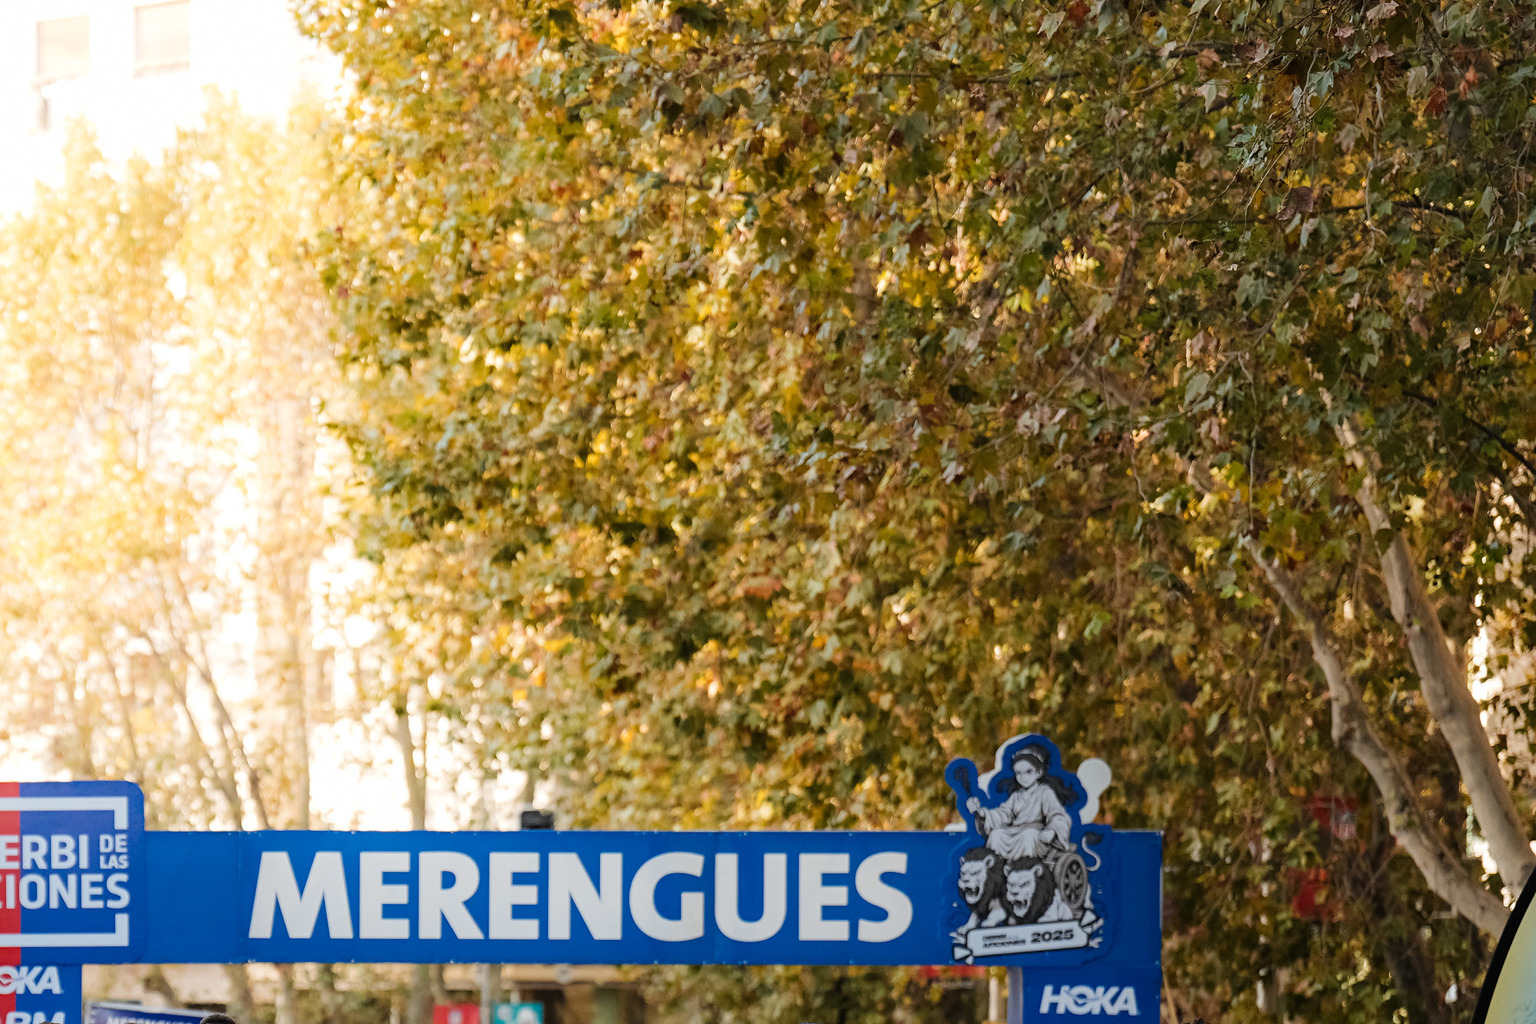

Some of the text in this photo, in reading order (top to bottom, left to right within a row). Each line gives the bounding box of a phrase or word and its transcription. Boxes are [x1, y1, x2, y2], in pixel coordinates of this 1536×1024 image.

[99, 834, 127, 853] DE
[99, 855, 128, 869] LAS
[248, 852, 914, 943] MERENGUES
[1031, 929, 1074, 944] 2025
[1039, 985, 1138, 1016] HOKA
